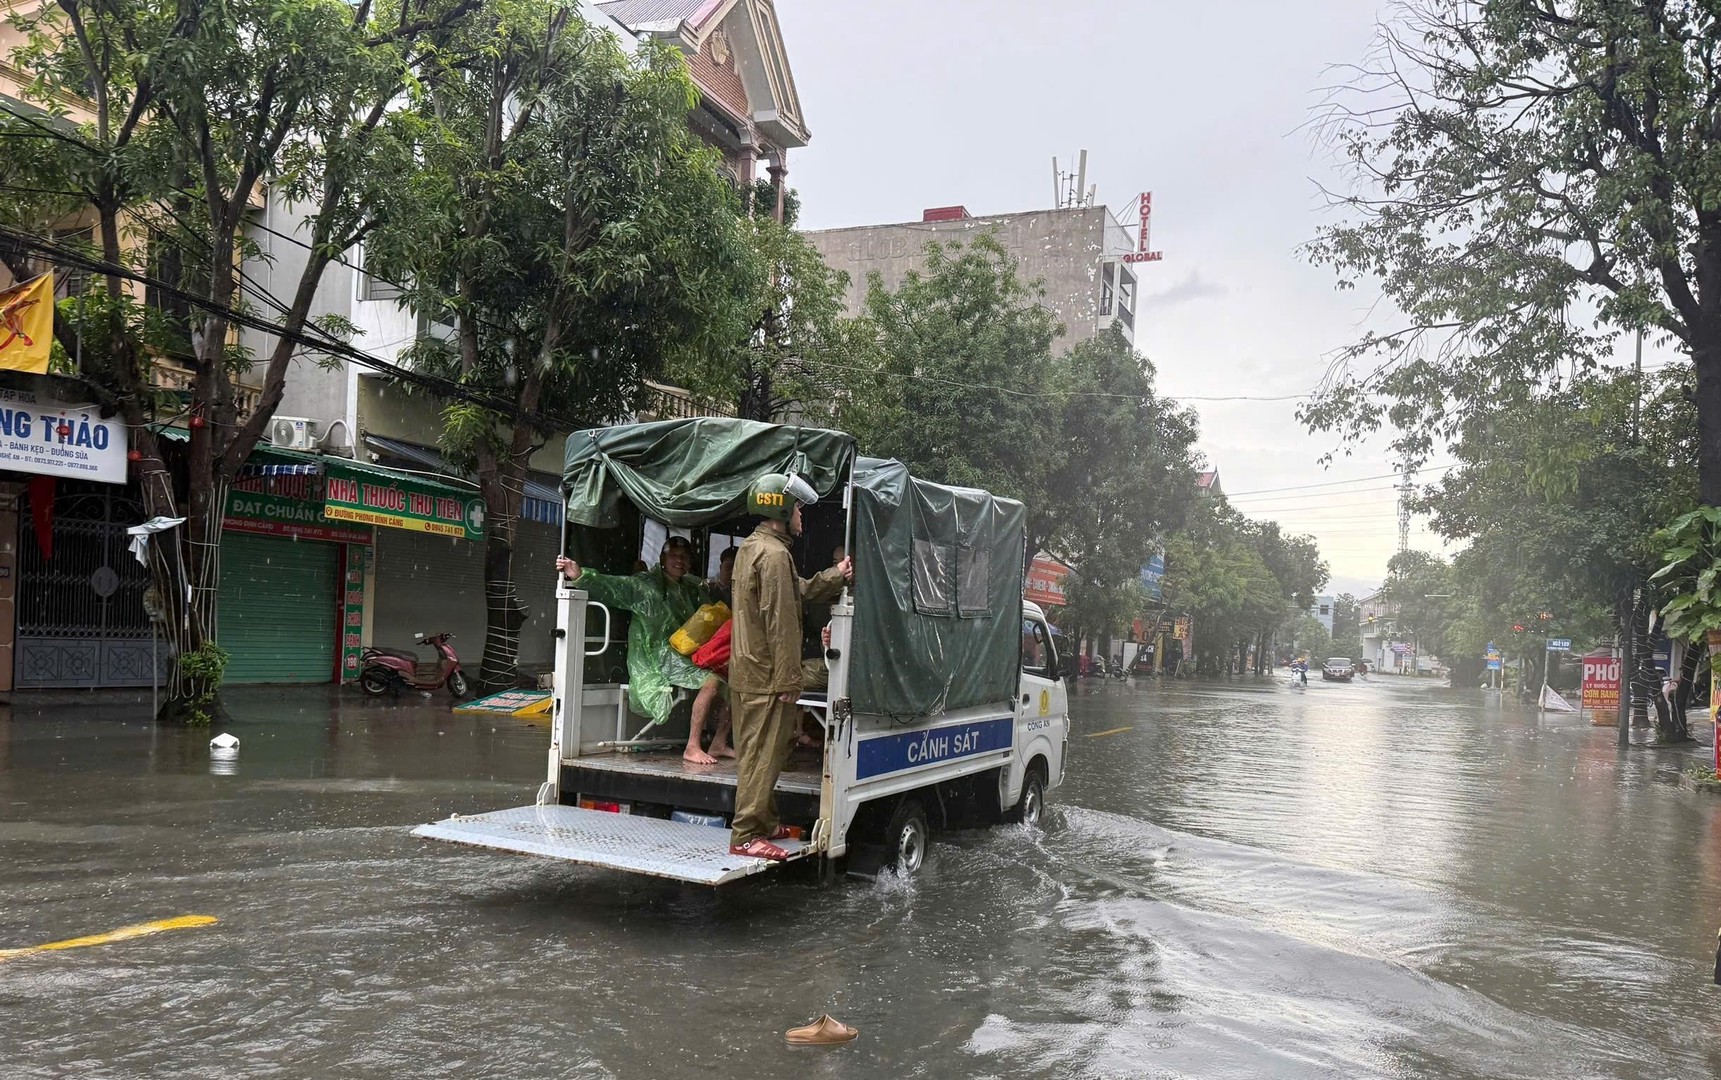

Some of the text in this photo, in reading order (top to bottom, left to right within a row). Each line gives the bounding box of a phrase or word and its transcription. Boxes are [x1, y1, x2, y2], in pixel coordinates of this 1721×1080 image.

[1140, 191, 1151, 252] HOTEL
[1123, 251, 1162, 263] GLOBAL
[41, 413, 109, 451] THẢO
[30, 444, 44, 455] KẸO
[232, 500, 262, 517] ĐẠT
[327, 477, 359, 505] NHÀ
[361, 482, 406, 511] THUỐC
[409, 491, 433, 517] THU
[1584, 659, 1620, 682] PHỞ
[1027, 720, 1043, 732] CÔNG
[907, 727, 979, 763] CẢNH SÁT
